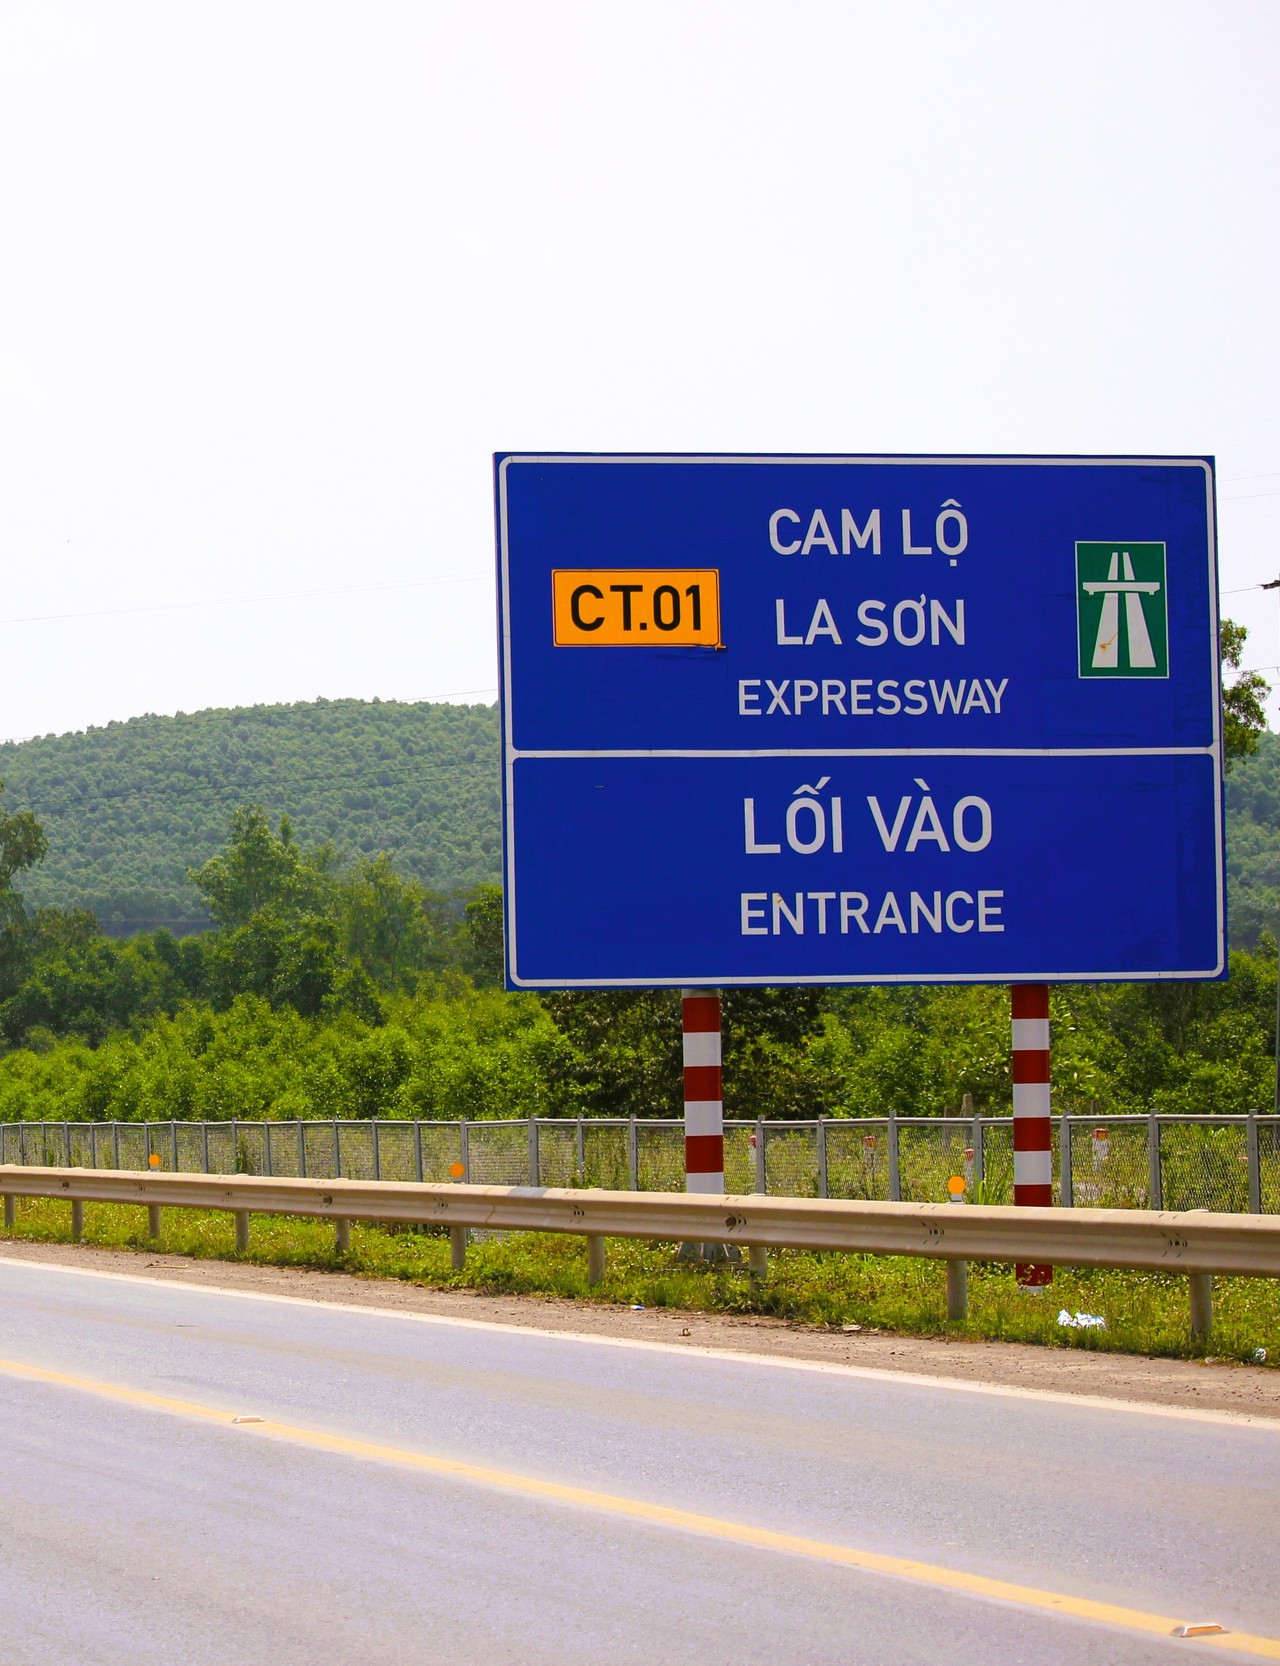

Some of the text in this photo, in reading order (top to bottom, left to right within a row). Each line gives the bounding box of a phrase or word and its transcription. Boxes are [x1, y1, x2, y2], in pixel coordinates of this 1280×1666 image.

[769, 499, 968, 566] CAM LỘ
[571, 585, 700, 631] CT.01
[776, 594, 965, 646] LA SƠN
[739, 679, 1008, 715] EXPRESSWAY
[744, 777, 992, 854] LỐI VÀO
[741, 890, 1004, 935] ENTRANCE
